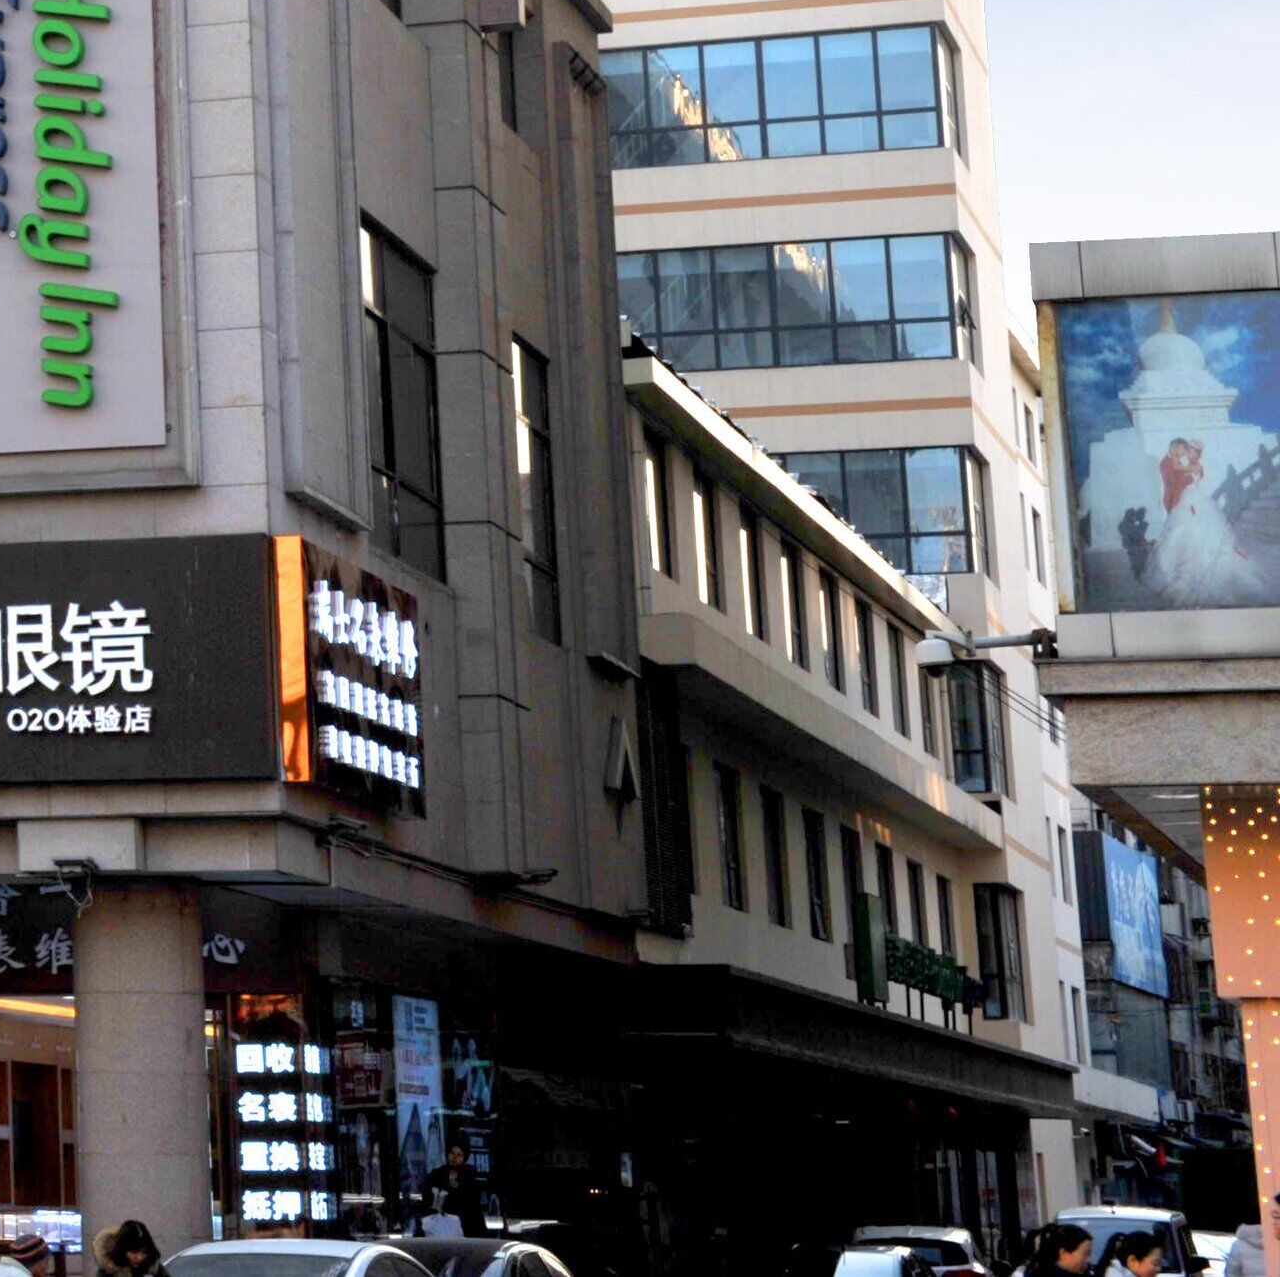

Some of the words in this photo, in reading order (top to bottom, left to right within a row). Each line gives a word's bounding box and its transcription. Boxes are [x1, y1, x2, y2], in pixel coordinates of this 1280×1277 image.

[40, 282, 121, 411] Inn
[6, 705, 153, 735] O2O体验店
[236, 1044, 295, 1073] 回收
[238, 1092, 297, 1122] 名表
[242, 1190, 302, 1222] 抵押
